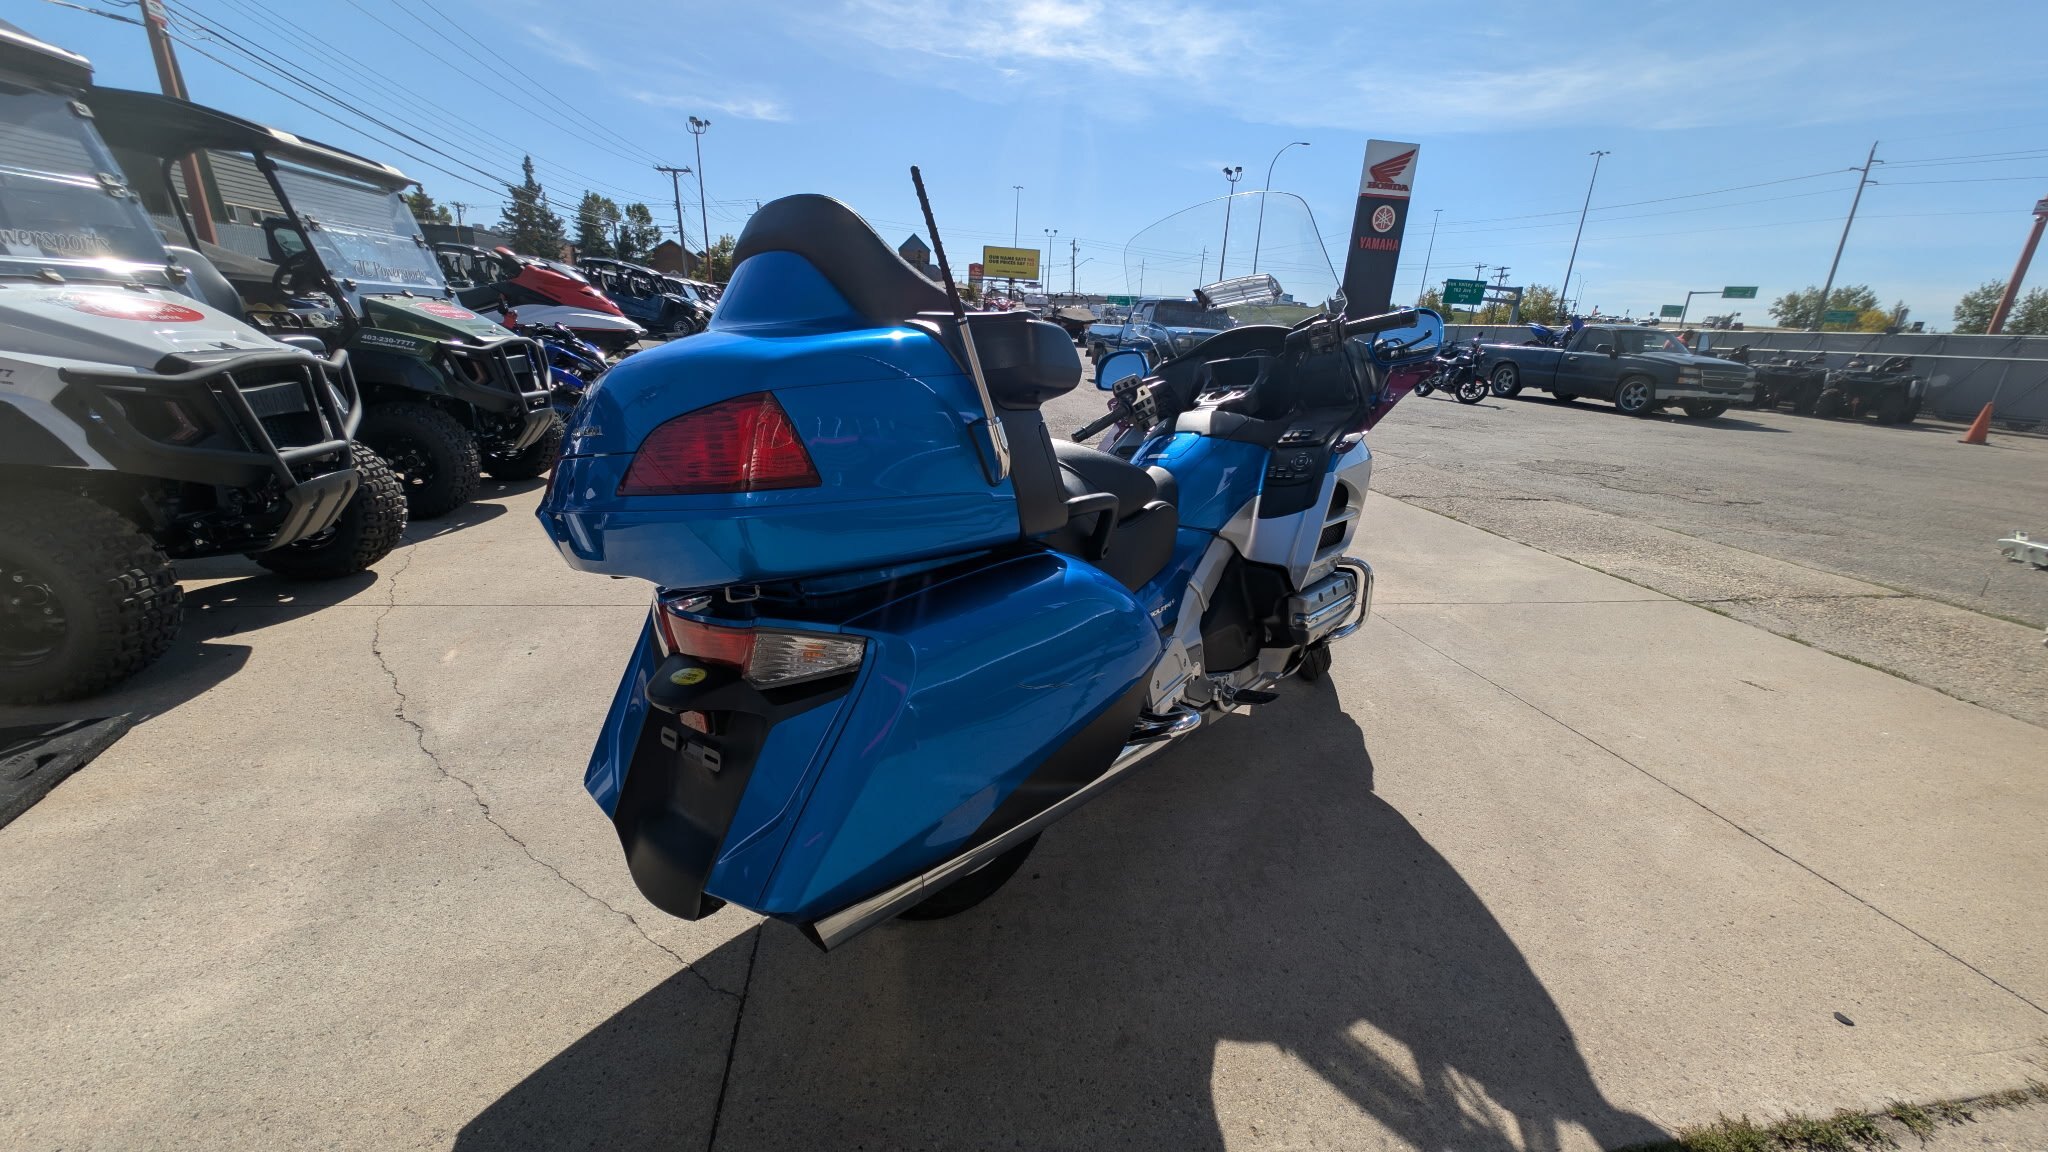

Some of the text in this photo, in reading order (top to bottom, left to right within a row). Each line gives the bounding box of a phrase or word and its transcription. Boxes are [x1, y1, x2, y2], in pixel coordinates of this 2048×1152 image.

[1367, 182, 1409, 191] HONDA
[1360, 237, 1398, 251] YAMAHA
[361, 334, 417, 347] 403-230-7777
